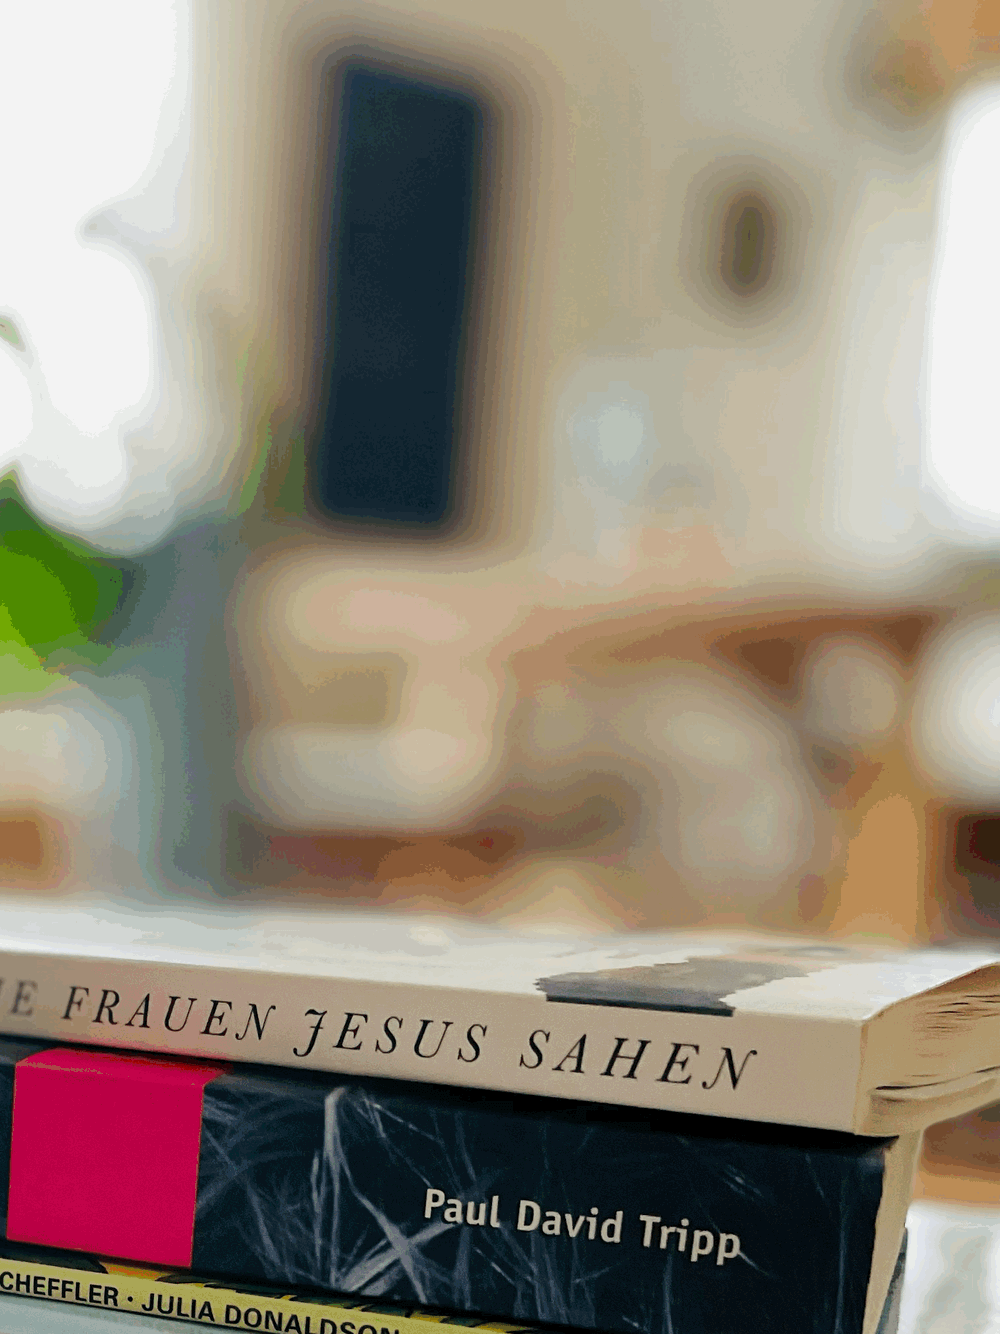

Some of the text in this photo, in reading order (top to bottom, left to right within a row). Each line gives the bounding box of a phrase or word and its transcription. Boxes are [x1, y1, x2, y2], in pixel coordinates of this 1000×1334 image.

[61, 985, 277, 1041] FRAUEN
[293, 1008, 489, 1062] JESUS
[520, 1030, 758, 1092] SAHEN
[424, 1188, 742, 1265] Paul David Tripp
[141, 1293, 215, 1322] JULIA
